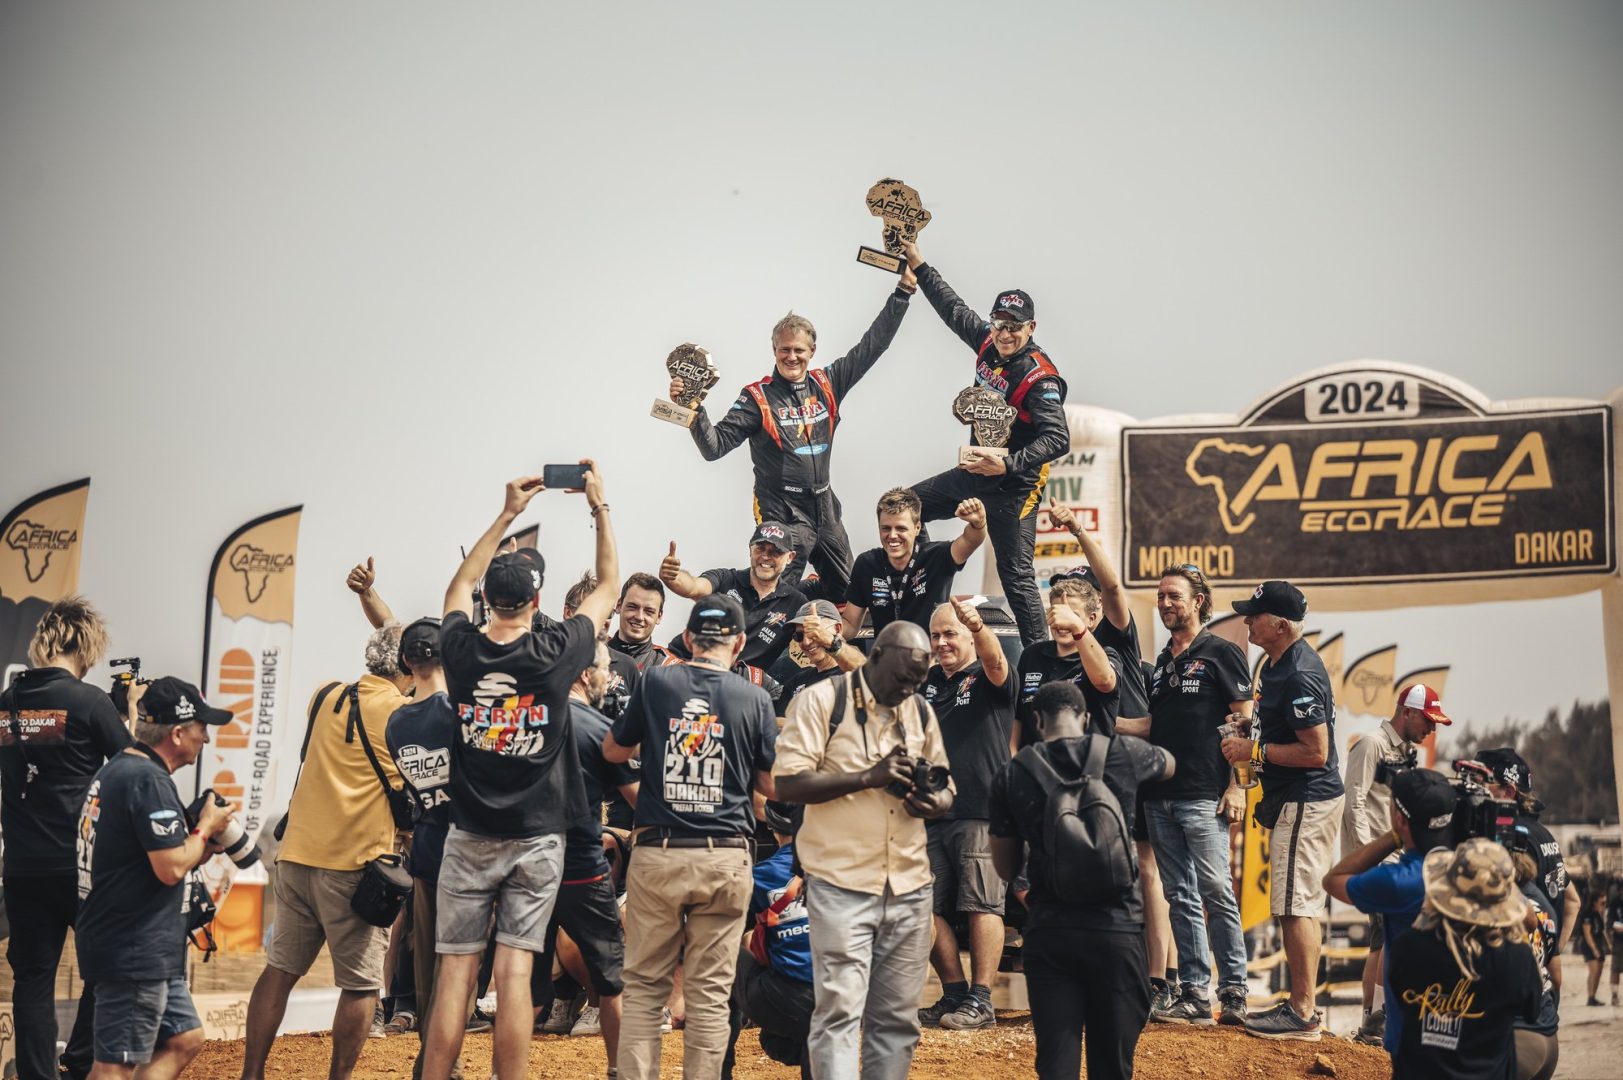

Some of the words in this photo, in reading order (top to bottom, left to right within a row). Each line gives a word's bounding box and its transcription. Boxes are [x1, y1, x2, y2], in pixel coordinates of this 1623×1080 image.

[870, 198, 928, 222] AFRICA
[668, 360, 711, 380] AFRICA
[1318, 380, 1408, 415] 2024
[963, 404, 1013, 417] AFRICA
[1229, 431, 1553, 516] AFRICA
[1300, 492, 1506, 532] ECORACE
[14, 529, 77, 545] AFRICA
[1514, 529, 1594, 565] DAKAR
[236, 553, 294, 568] AFRICA
[1139, 545, 1235, 577] MONACO
[256, 649, 279, 736] EXPERIENCE
[1182, 686, 1200, 694] SPORT
[29, 718, 56, 727] DAKAR
[457, 703, 549, 728] FERYN
[669, 717, 725, 738] FERYN
[665, 753, 722, 787] 210
[665, 783, 721, 803] DAKAR
[1402, 978, 1486, 1020] Rally
